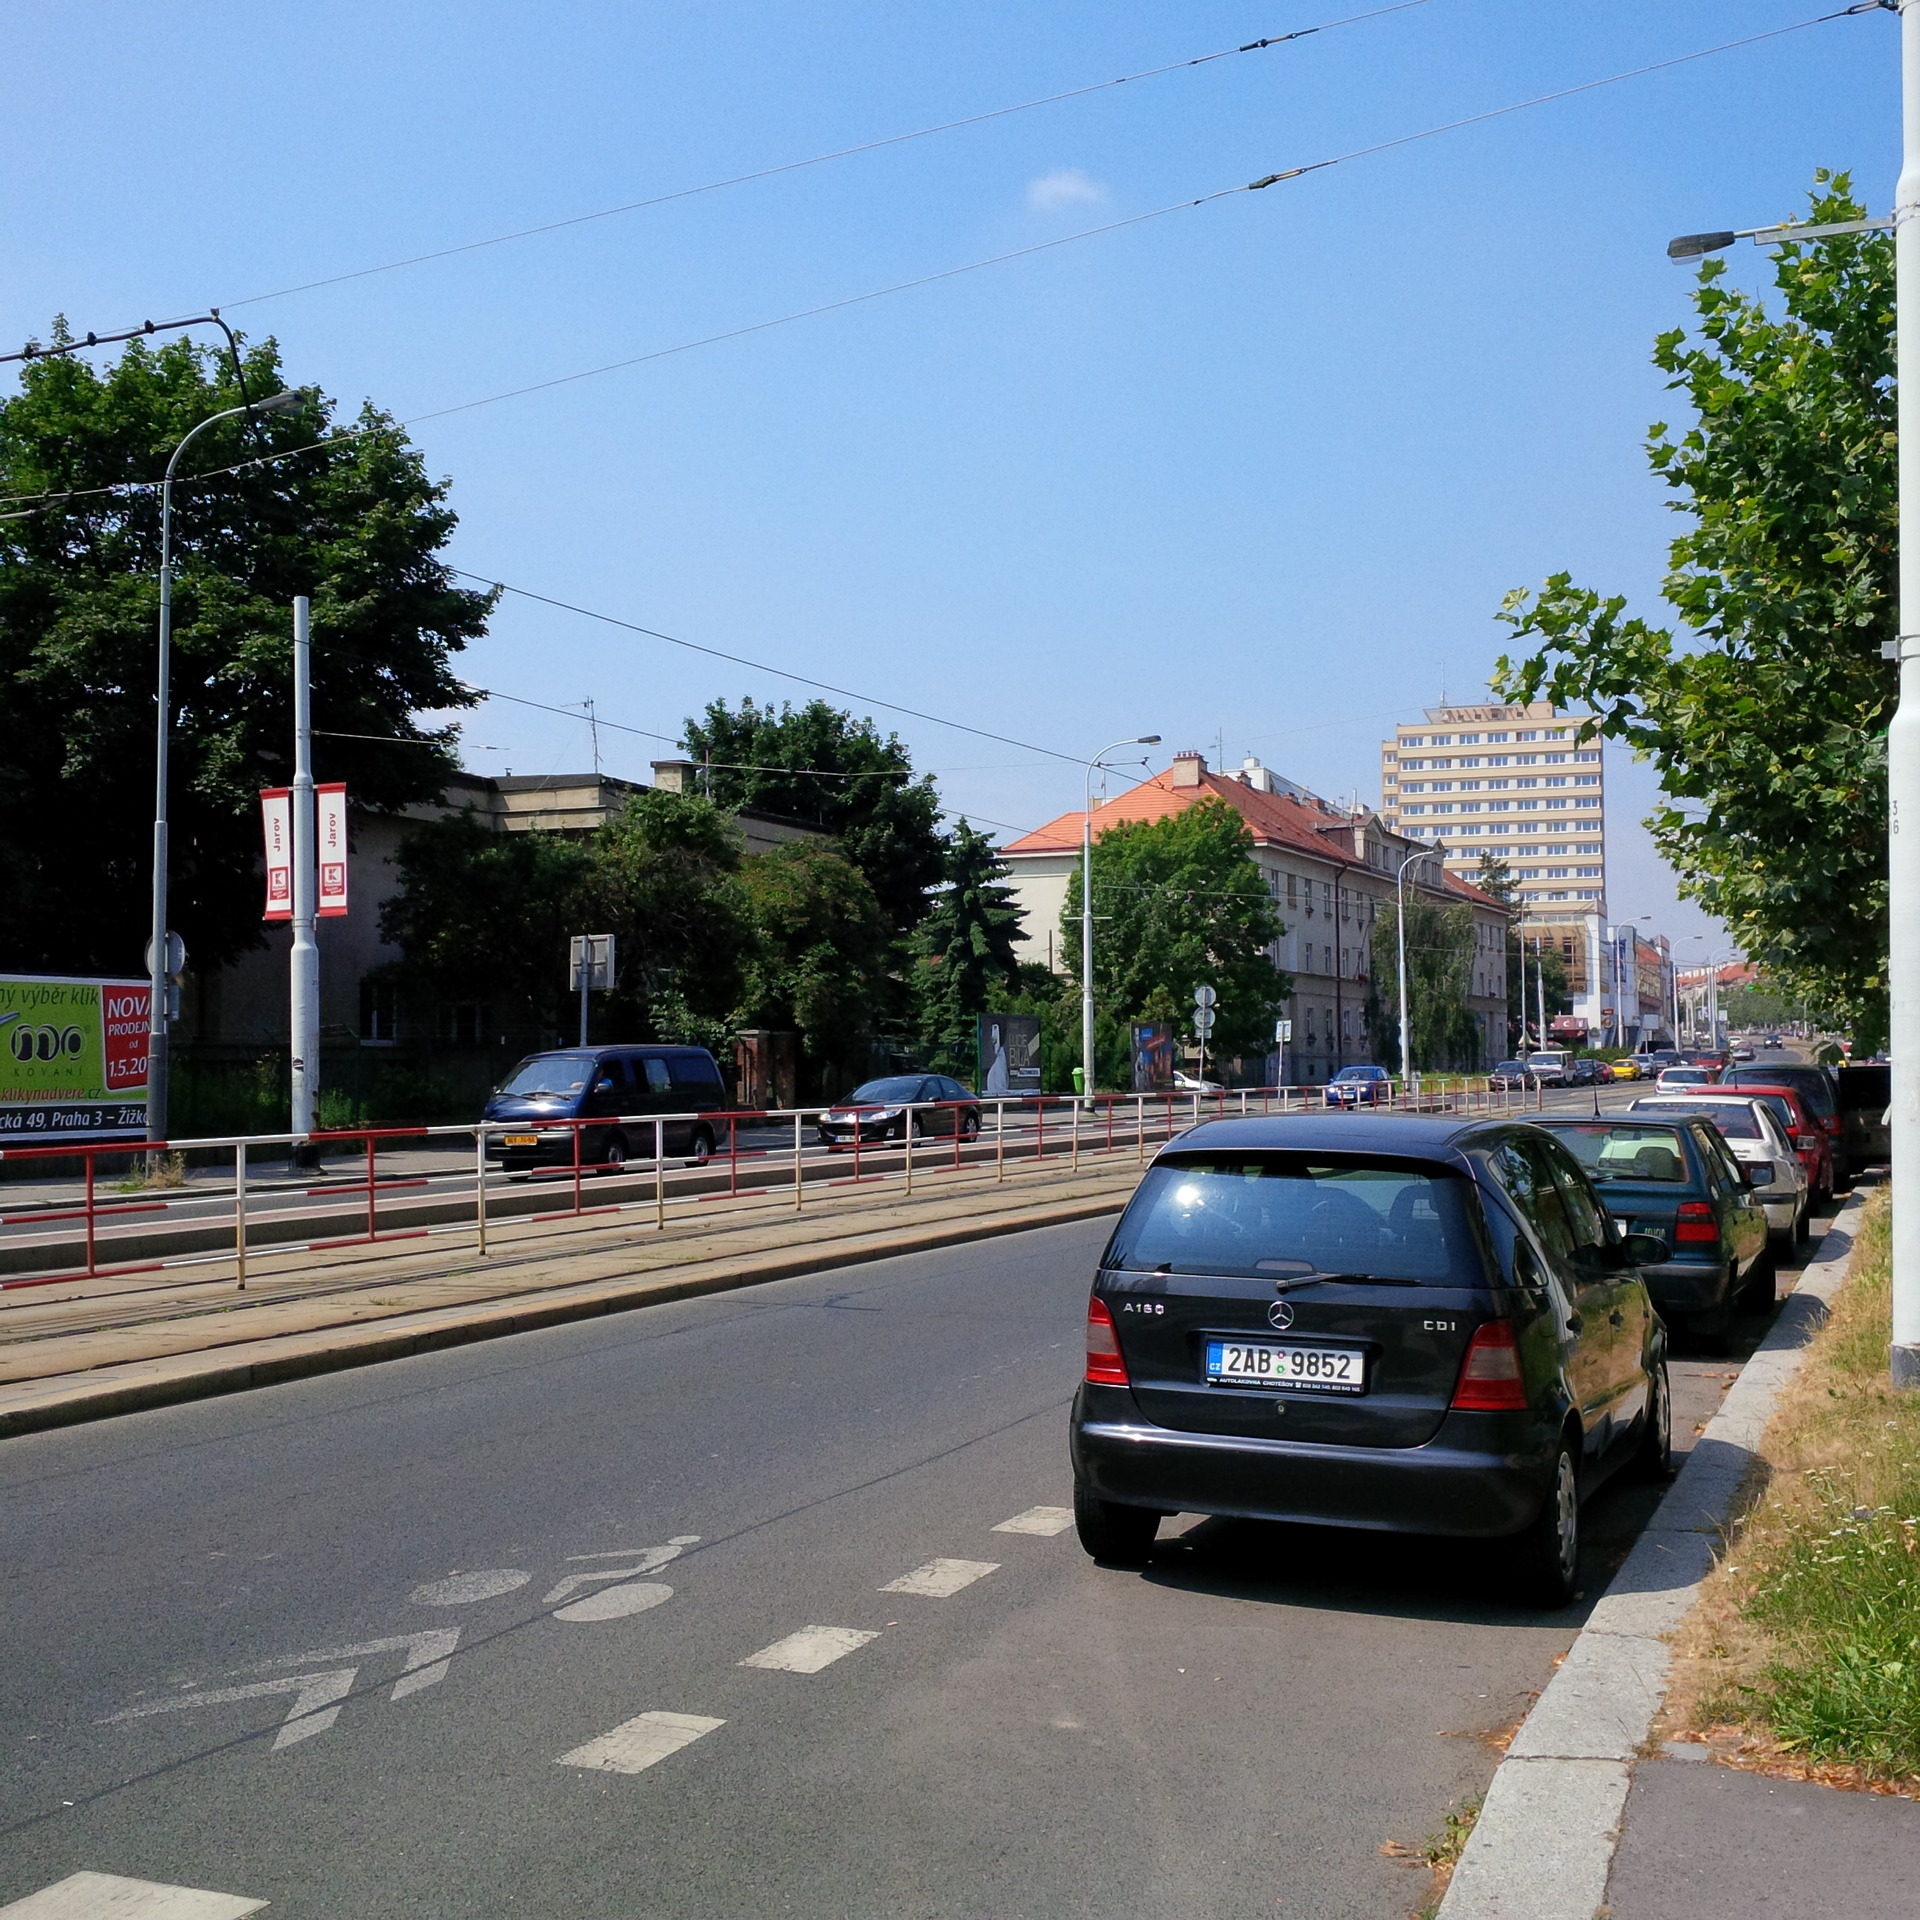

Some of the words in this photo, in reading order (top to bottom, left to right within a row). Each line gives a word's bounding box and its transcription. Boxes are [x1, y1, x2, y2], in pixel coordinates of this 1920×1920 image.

[273, 818, 281, 852] Jarov
[328, 813, 337, 847] Jarov
[21, 986, 67, 1009] výběr
[71, 987, 99, 1006] klik
[129, 1040, 139, 1049] od
[27, 1112, 47, 1129] 49,
[52, 1111, 90, 1126] Praha
[94, 1111, 103, 1126] 3
[1423, 1320, 1456, 1331] CDI
[1209, 1362, 1221, 1371] CZ
[1228, 1347, 1271, 1374] 2AB
[1291, 1350, 1351, 1380] 9852
